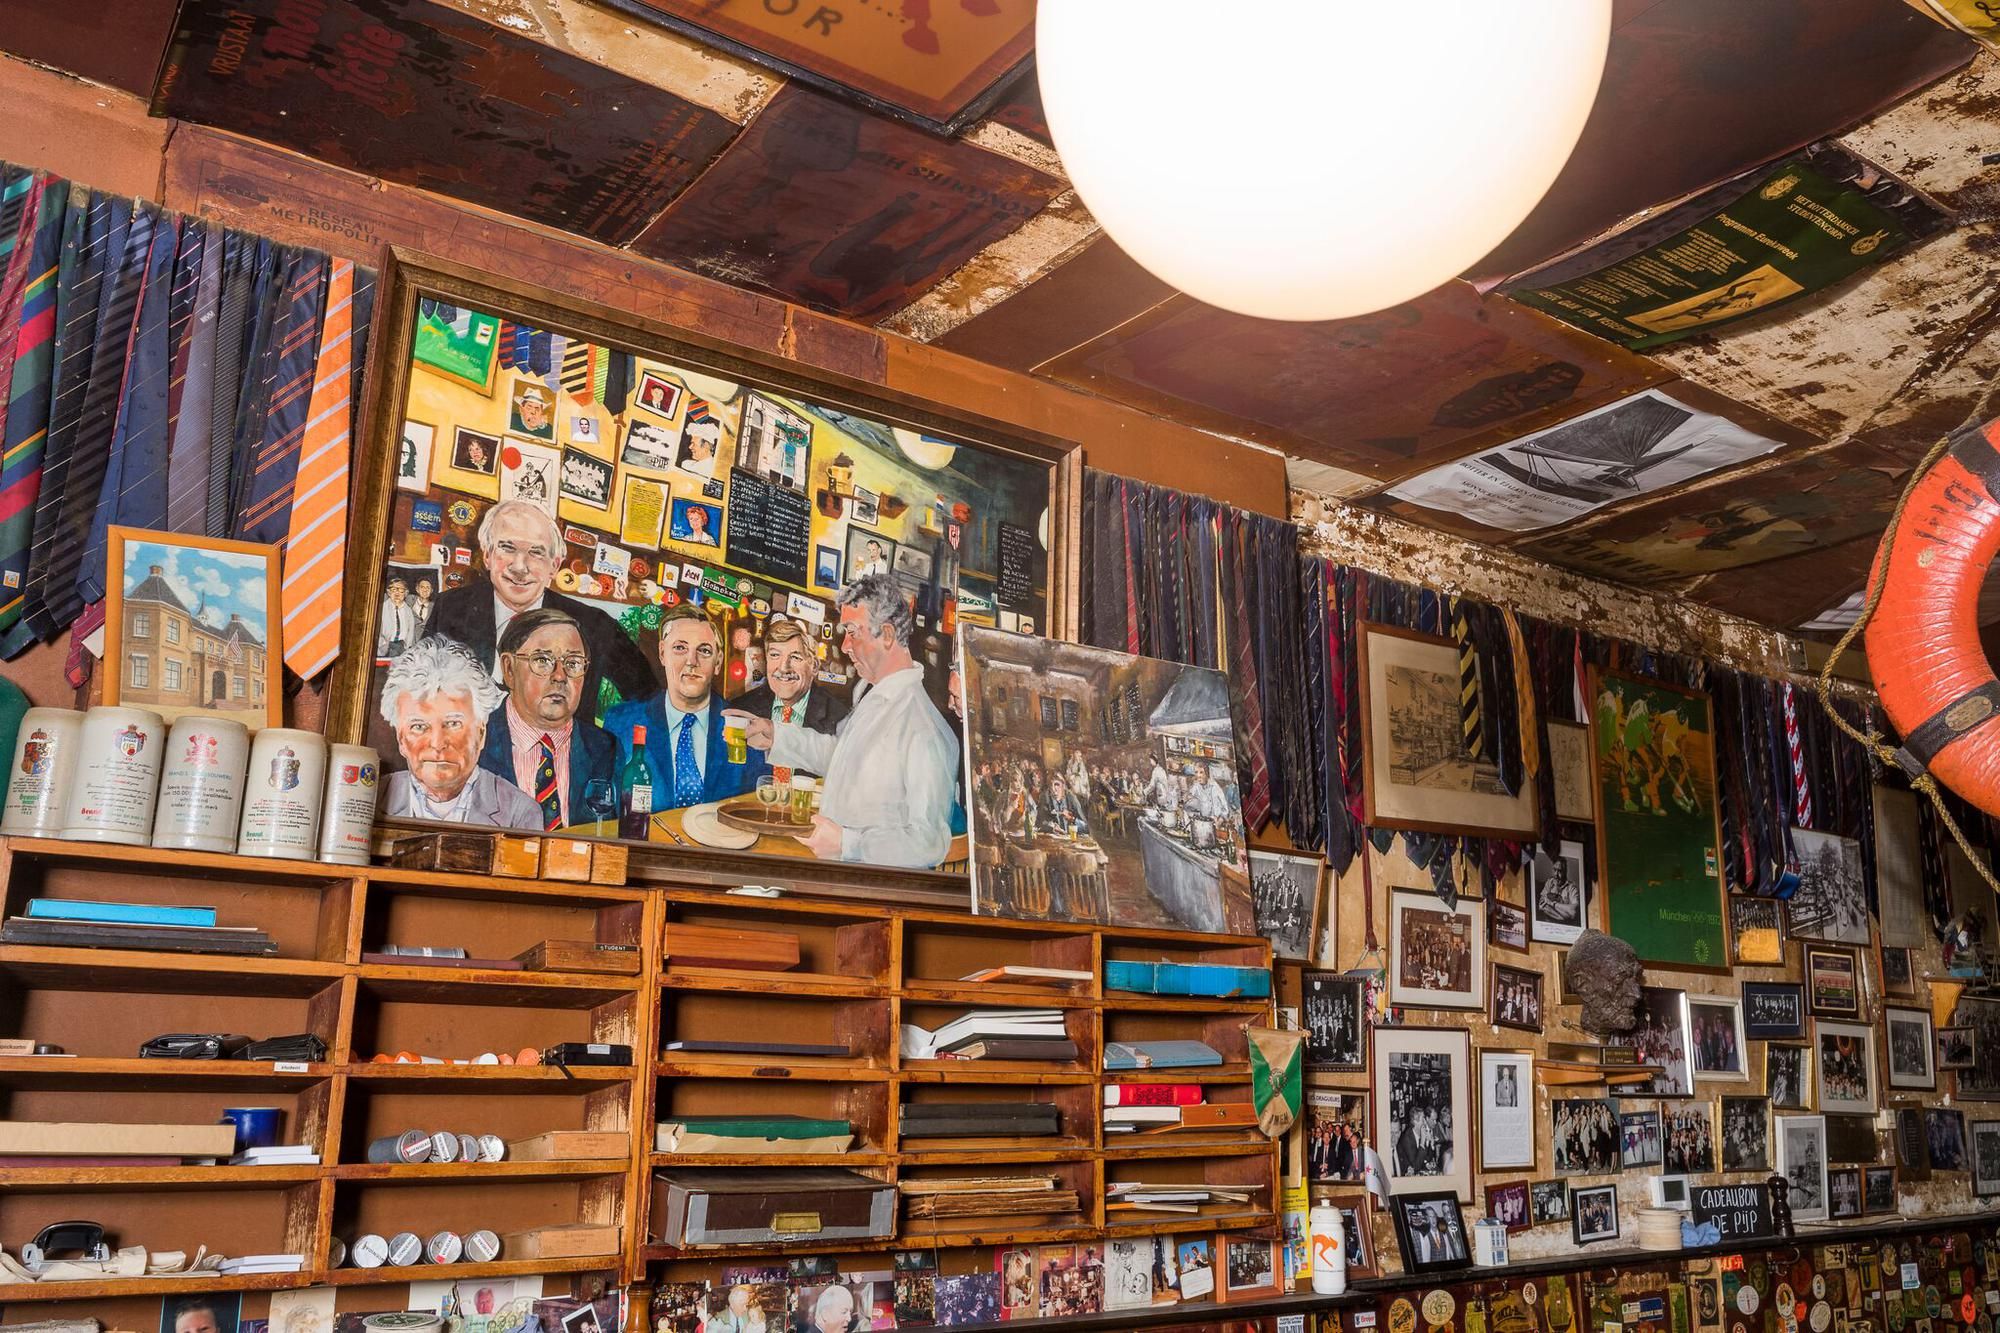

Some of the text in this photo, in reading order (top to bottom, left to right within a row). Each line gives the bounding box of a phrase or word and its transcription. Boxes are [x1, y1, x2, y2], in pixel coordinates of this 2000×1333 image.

[703, 579, 738, 601] Heineken
[1700, 1187, 1758, 1209] CADEAUBON
[1711, 1213, 1729, 1234] DE
